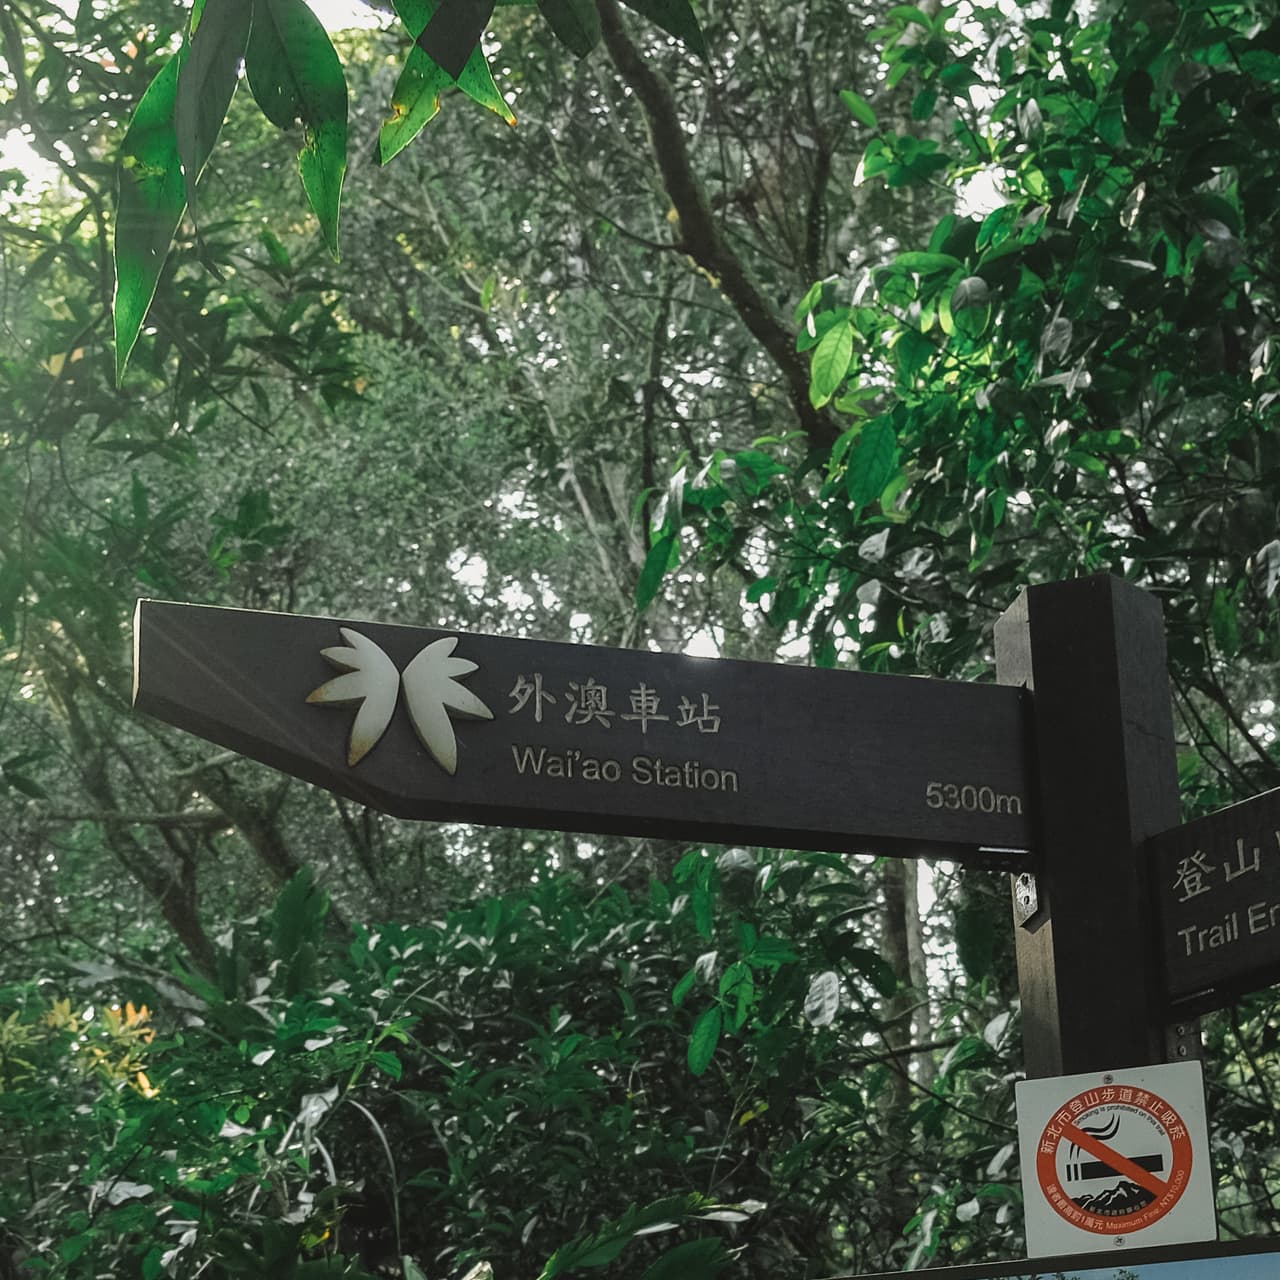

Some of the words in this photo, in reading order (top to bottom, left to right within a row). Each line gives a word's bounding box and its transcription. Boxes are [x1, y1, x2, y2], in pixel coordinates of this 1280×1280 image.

[508, 671, 722, 735] 外澳車站
[512, 744, 621, 784] Wai'ao
[633, 755, 739, 794] Station
[926, 780, 1023, 816] 5300m
[1177, 918, 1240, 958] Trail
[1040, 1088, 1187, 1155] 新北市登山步道禁止吸菸
[1073, 1108, 1100, 1126] Smoking
[1106, 1104, 1139, 1115] prohibited
[1138, 1110, 1147, 1118] on
[1106, 1216, 1143, 1230] Maximum
